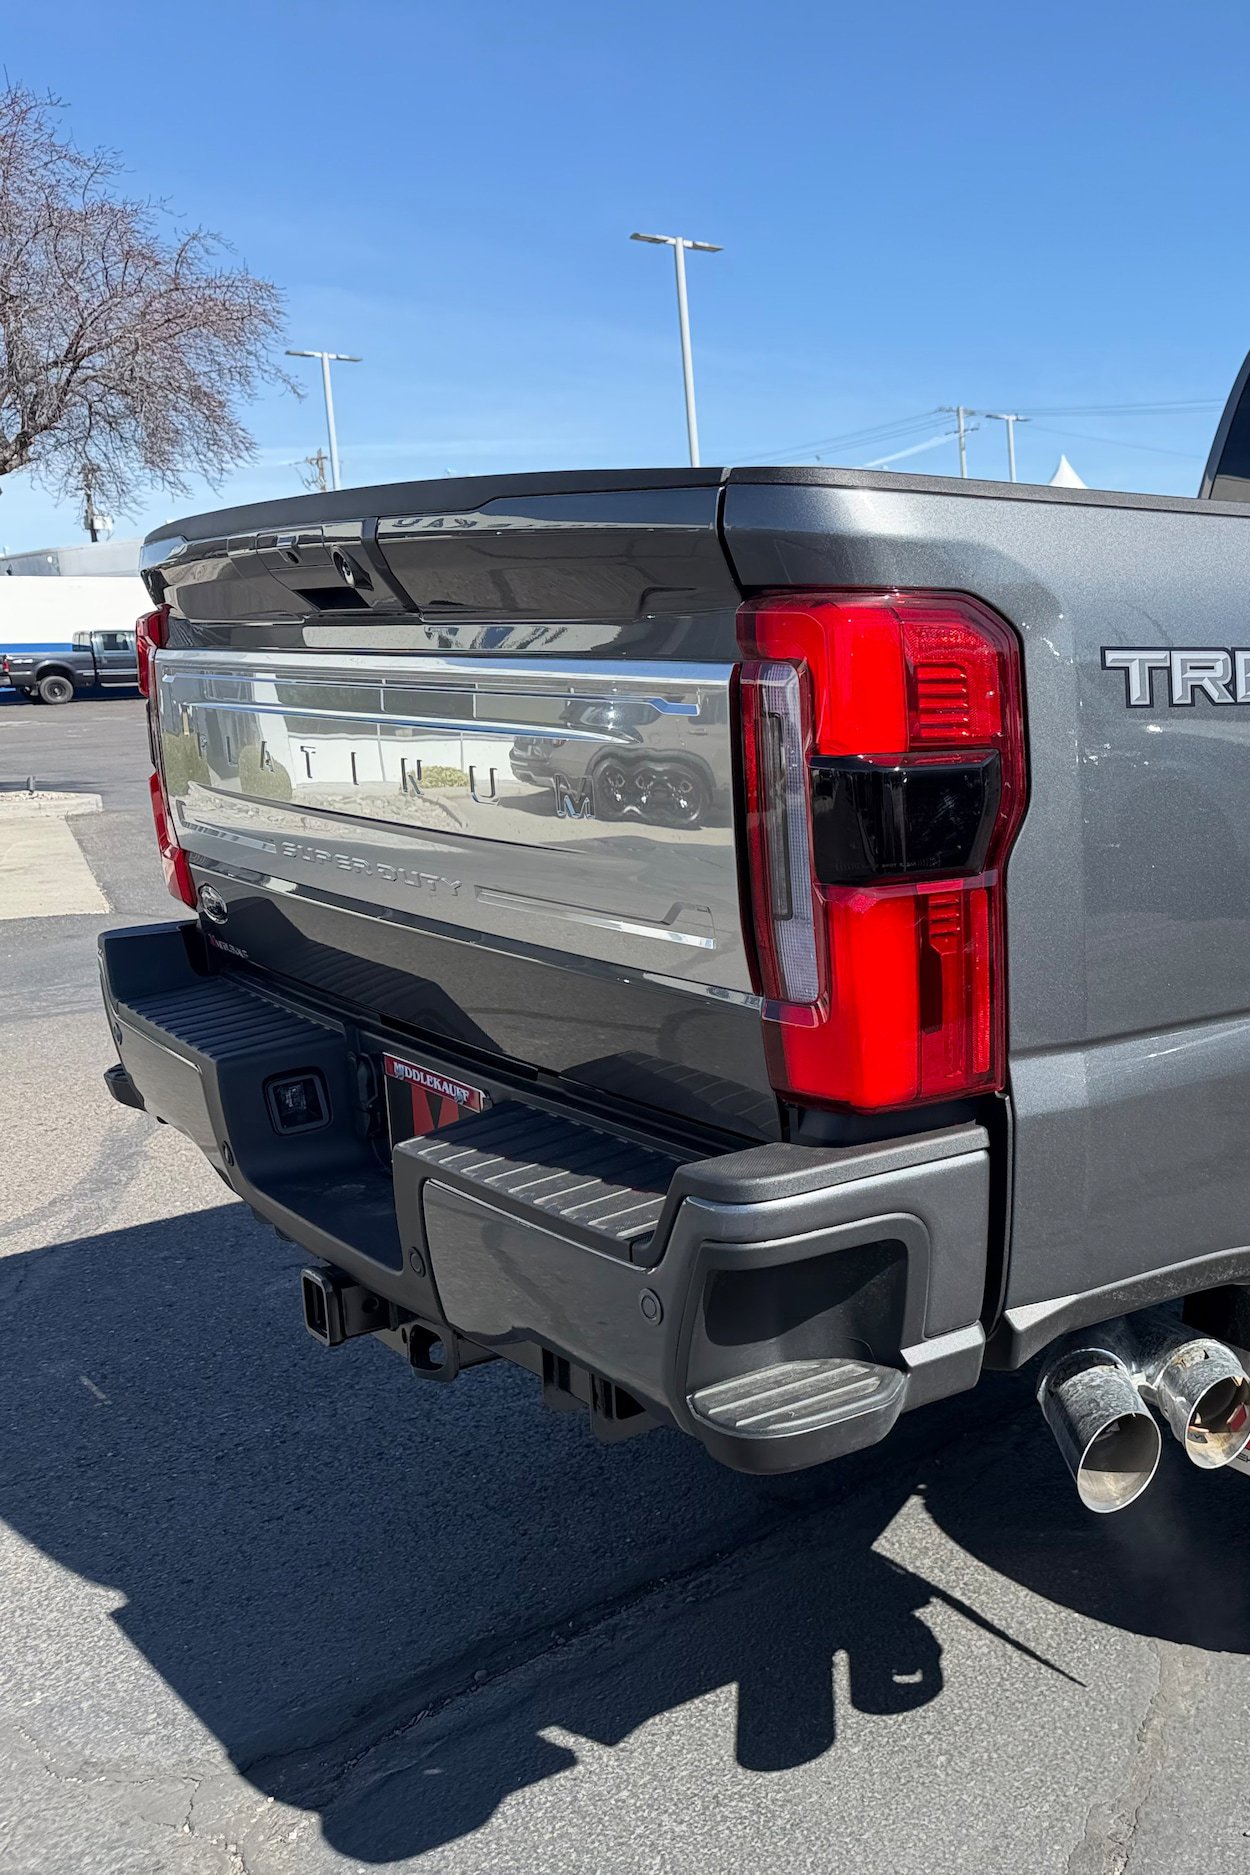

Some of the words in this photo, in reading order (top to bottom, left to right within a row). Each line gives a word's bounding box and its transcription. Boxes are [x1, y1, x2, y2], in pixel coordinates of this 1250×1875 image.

[197, 731, 597, 820] PLATINUM
[281, 841, 373, 876] SUPER
[376, 862, 463, 897] DUTY
